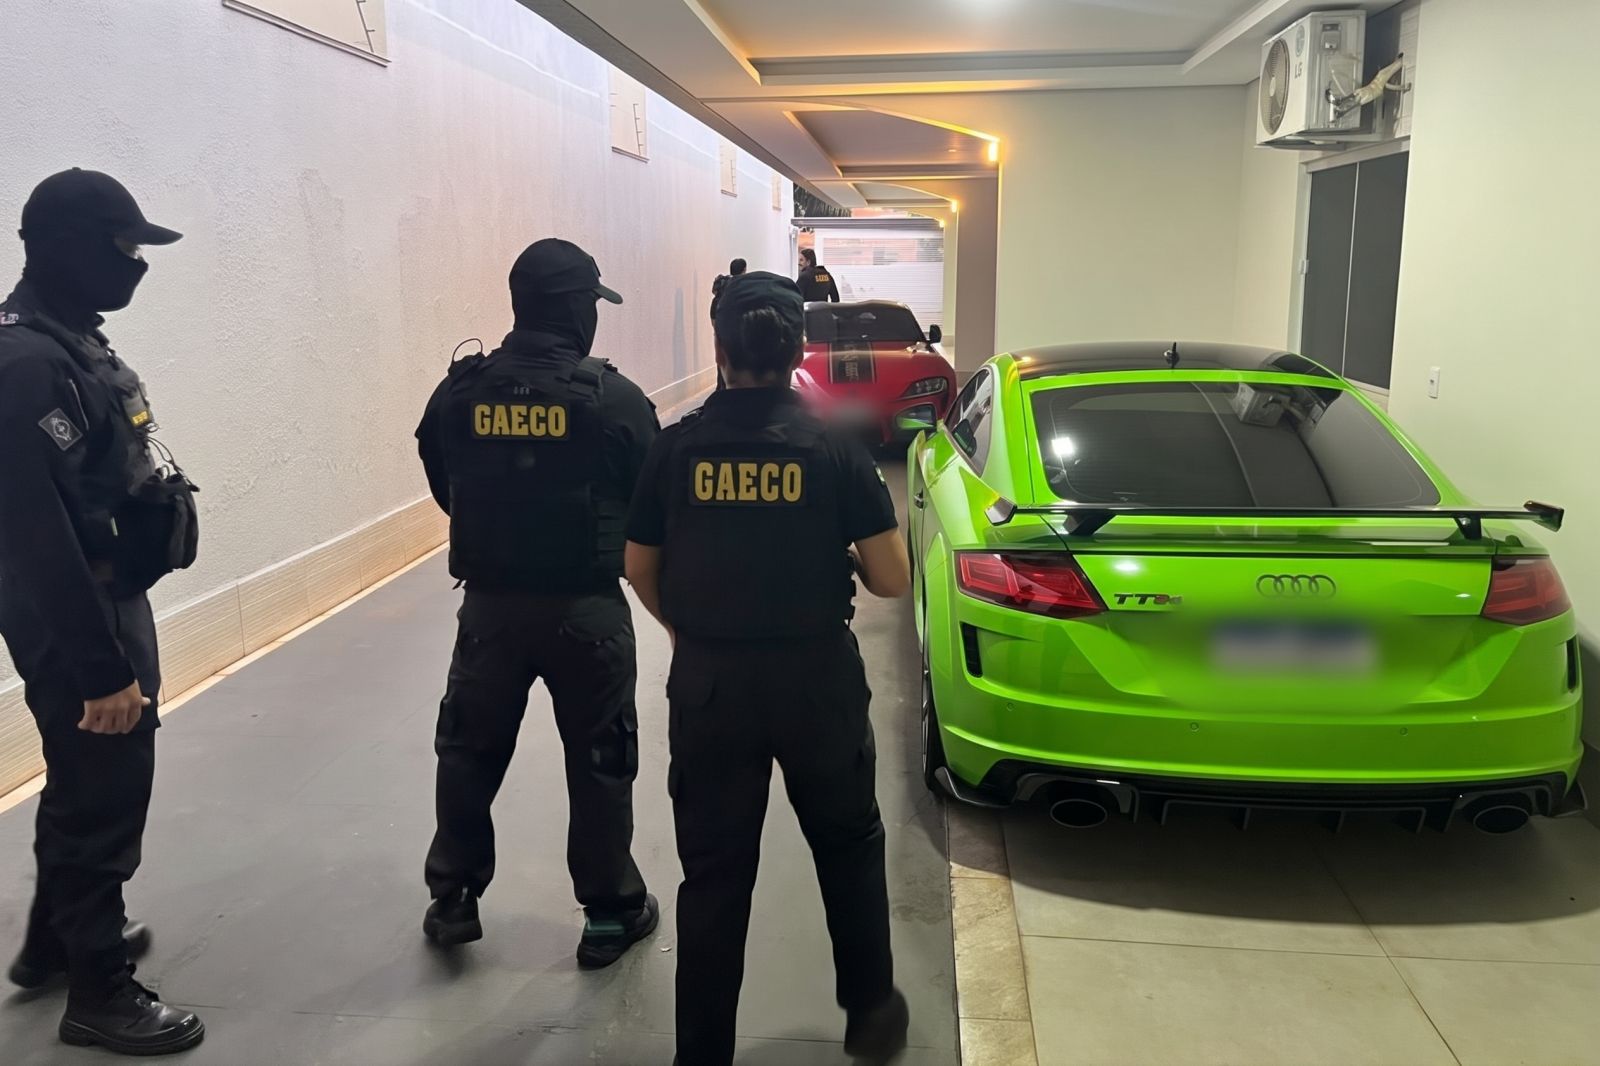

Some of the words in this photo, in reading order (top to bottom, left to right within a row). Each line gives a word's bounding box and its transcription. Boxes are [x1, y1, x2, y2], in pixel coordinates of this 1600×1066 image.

[1294, 61, 1303, 79] LG
[474, 404, 566, 437] GAECO
[695, 462, 802, 502] GAECO
